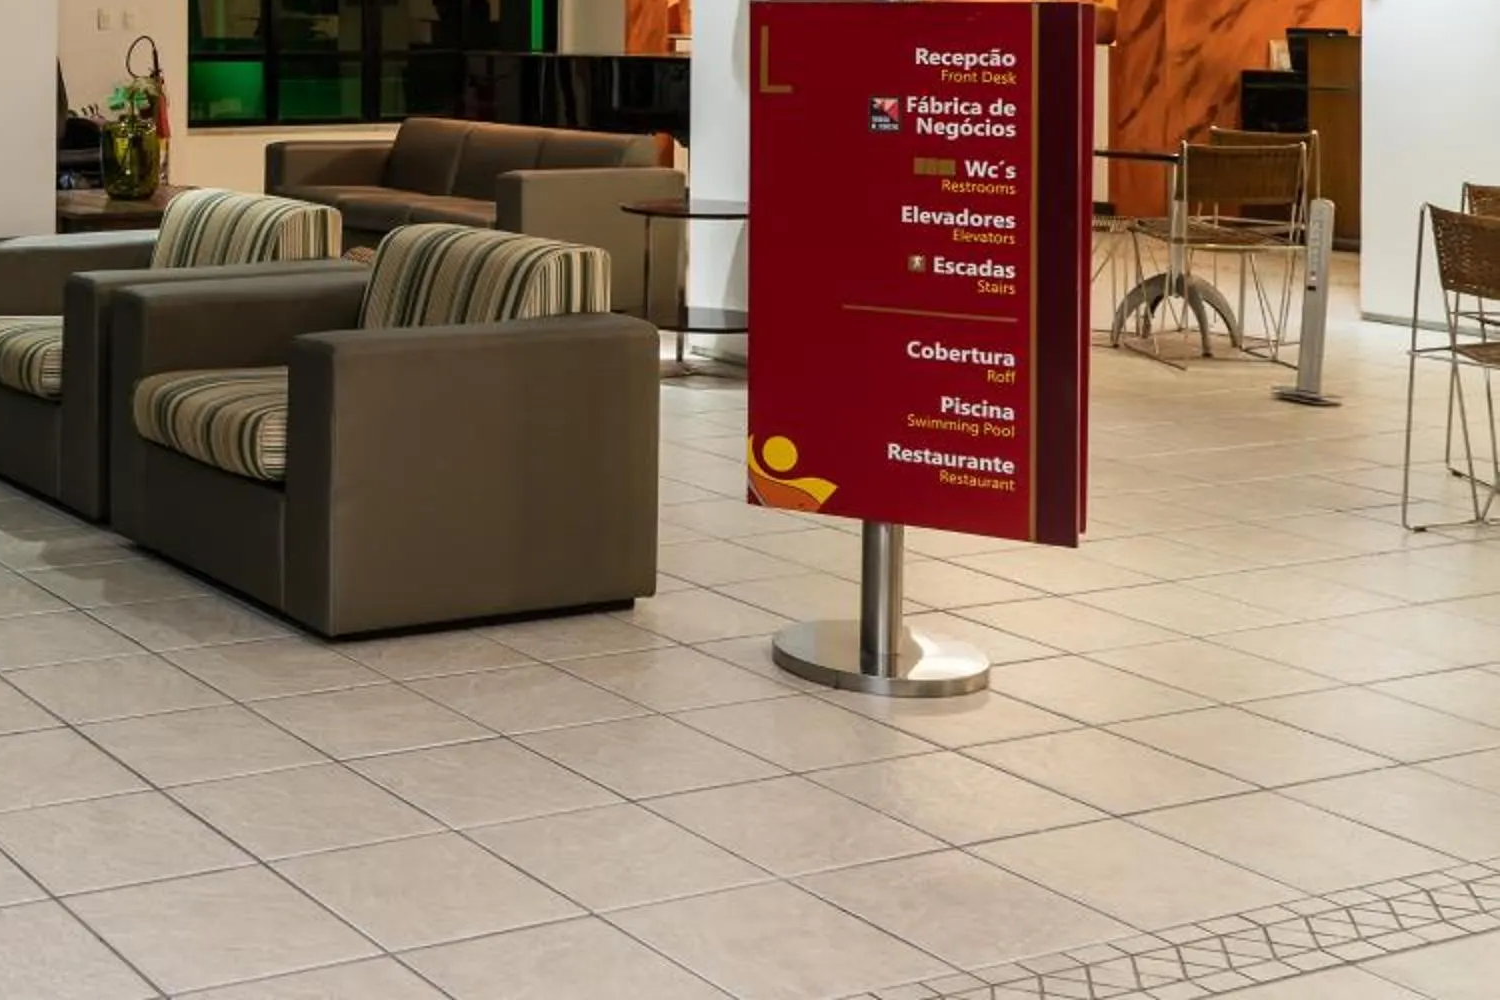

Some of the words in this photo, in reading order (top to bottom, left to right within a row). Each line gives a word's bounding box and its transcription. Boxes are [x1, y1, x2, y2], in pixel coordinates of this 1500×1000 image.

[941, 70, 977, 82] Front
[982, 71, 1016, 84] Desk
[907, 96, 982, 115] Fábrica
[989, 98, 1016, 116] de
[917, 117, 1016, 140] Negócios
[942, 179, 1016, 195] Restrooms
[902, 206, 1015, 229] Elevadores
[953, 229, 1015, 244] Elevators
[934, 257, 1015, 278] Escadas
[978, 280, 1015, 295] Stairs
[907, 341, 1015, 367] Cobertura
[987, 370, 1015, 384] Roff
[941, 396, 1014, 420] Piscina
[908, 413, 979, 436] Swimming
[983, 422, 1015, 437] Pool
[888, 443, 1015, 474] Restaurante
[940, 470, 1015, 490] Restaurant
